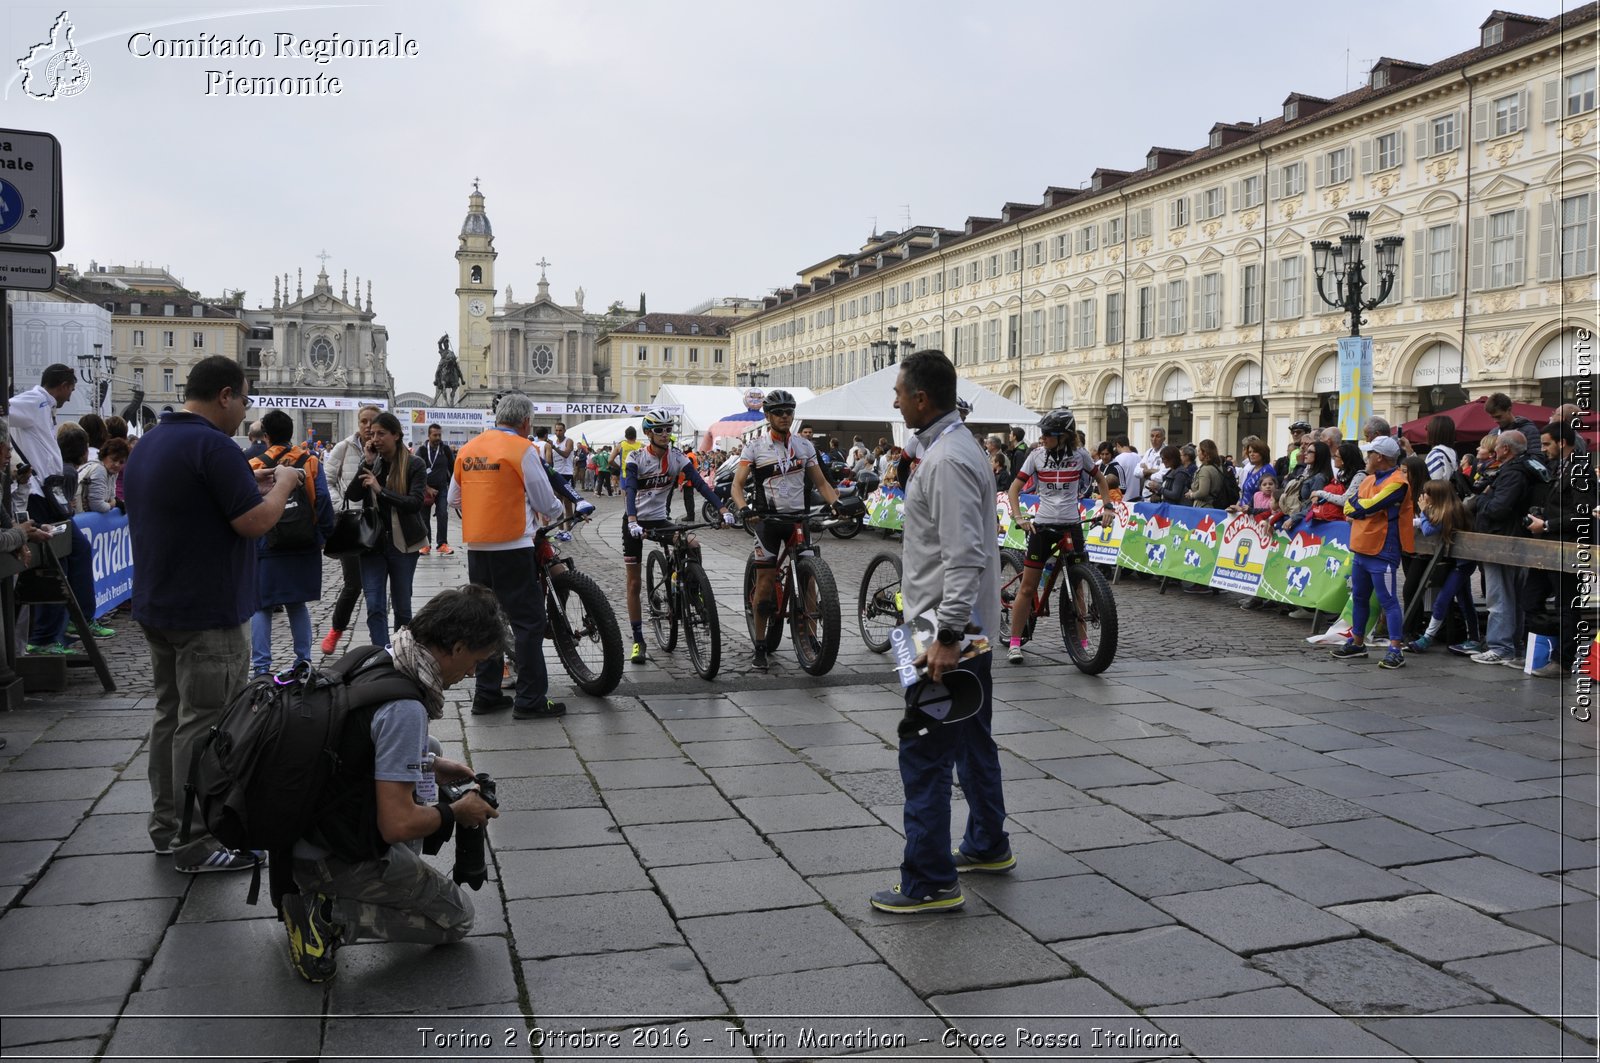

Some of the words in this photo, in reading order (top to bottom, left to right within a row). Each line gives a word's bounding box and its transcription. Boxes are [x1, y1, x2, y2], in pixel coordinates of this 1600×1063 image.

[259, 397, 327, 408] PARTENZA
[566, 403, 628, 414] PARTENZA
[426, 411, 446, 420] TURIN
[447, 412, 483, 420] MARATHON
[473, 463, 500, 471] MARATHON
[891, 628, 917, 685] TORINO
